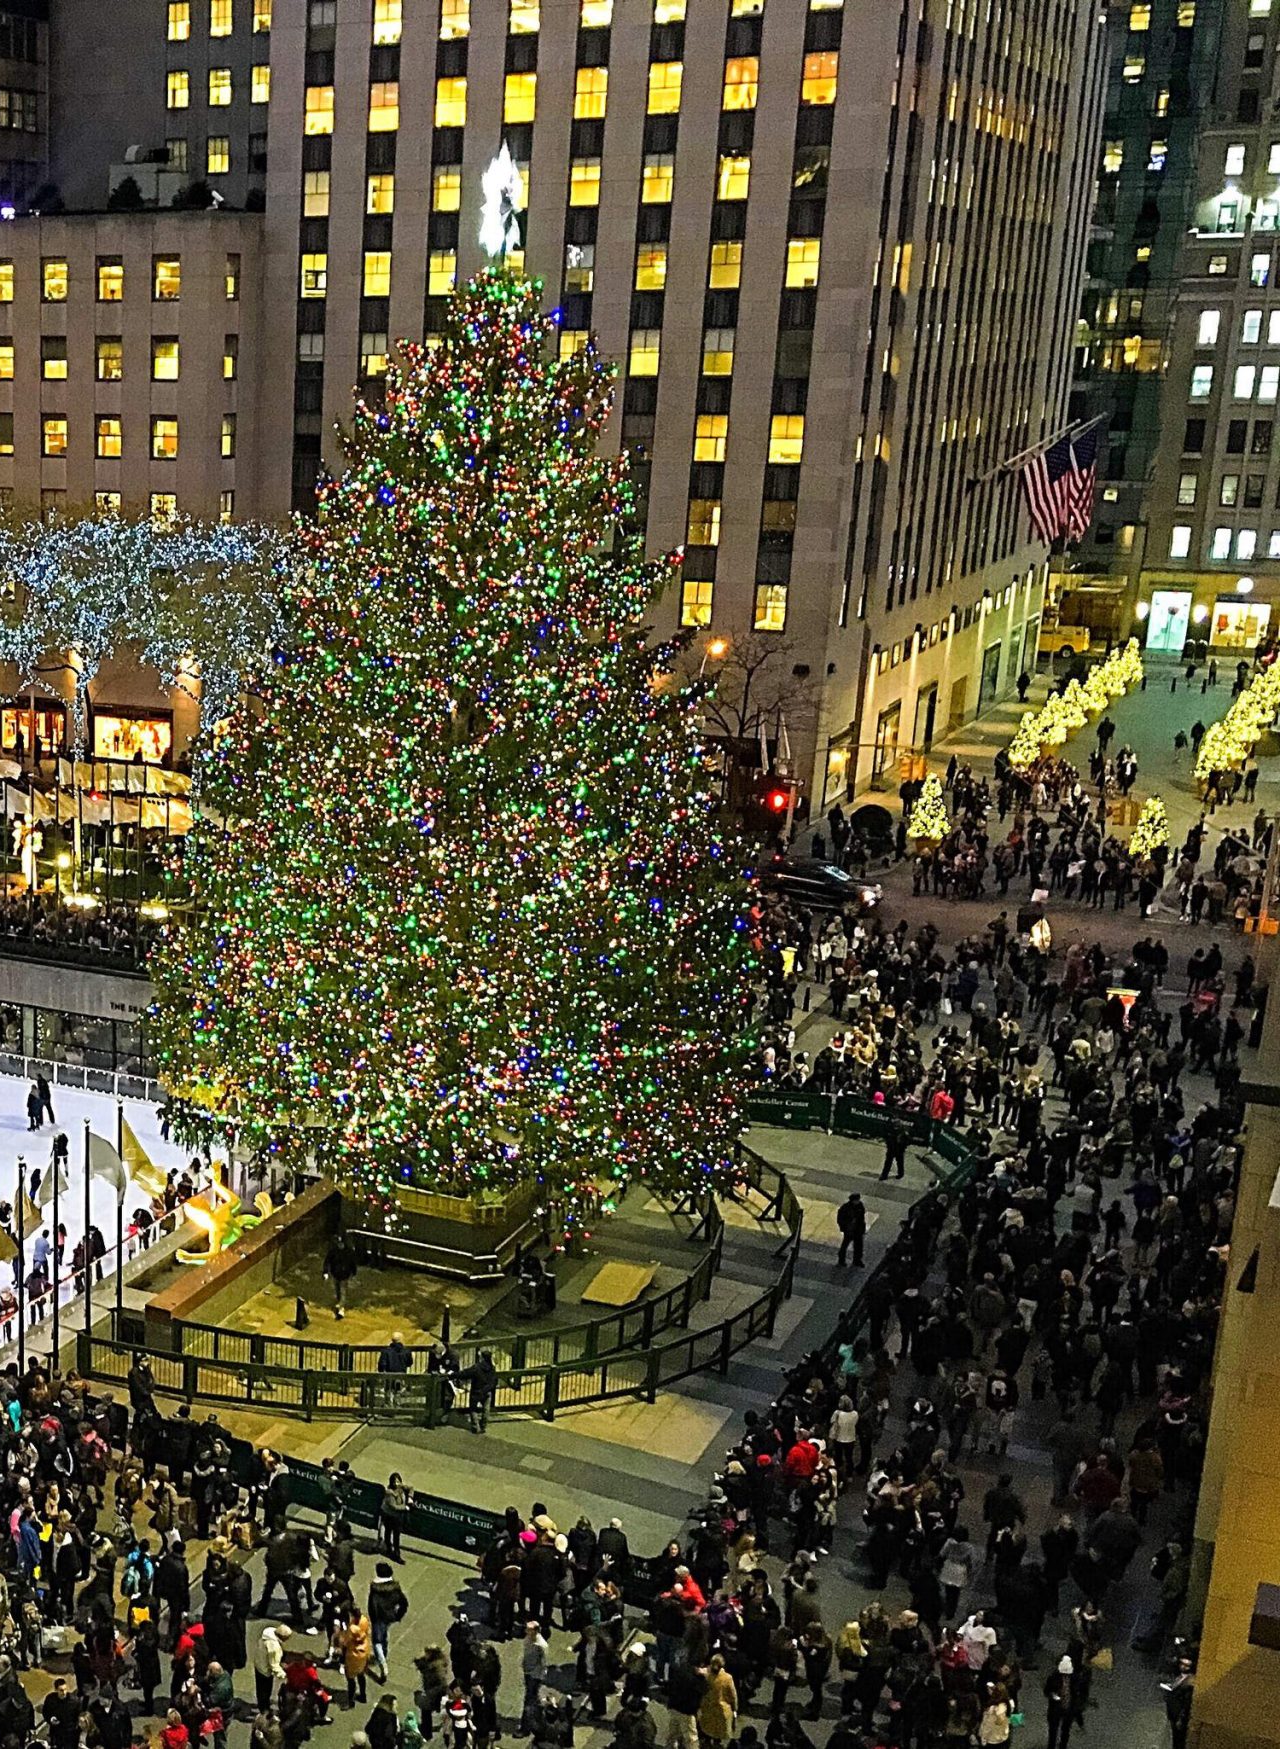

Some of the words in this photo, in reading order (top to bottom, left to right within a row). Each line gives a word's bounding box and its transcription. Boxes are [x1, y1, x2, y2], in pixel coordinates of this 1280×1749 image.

[110, 1001, 126, 1012] THE
[747, 1097, 783, 1106] ockefeller
[785, 1100, 809, 1108] Center
[850, 1106, 890, 1122] Rockefeller
[467, 1516, 493, 1530] Cent
